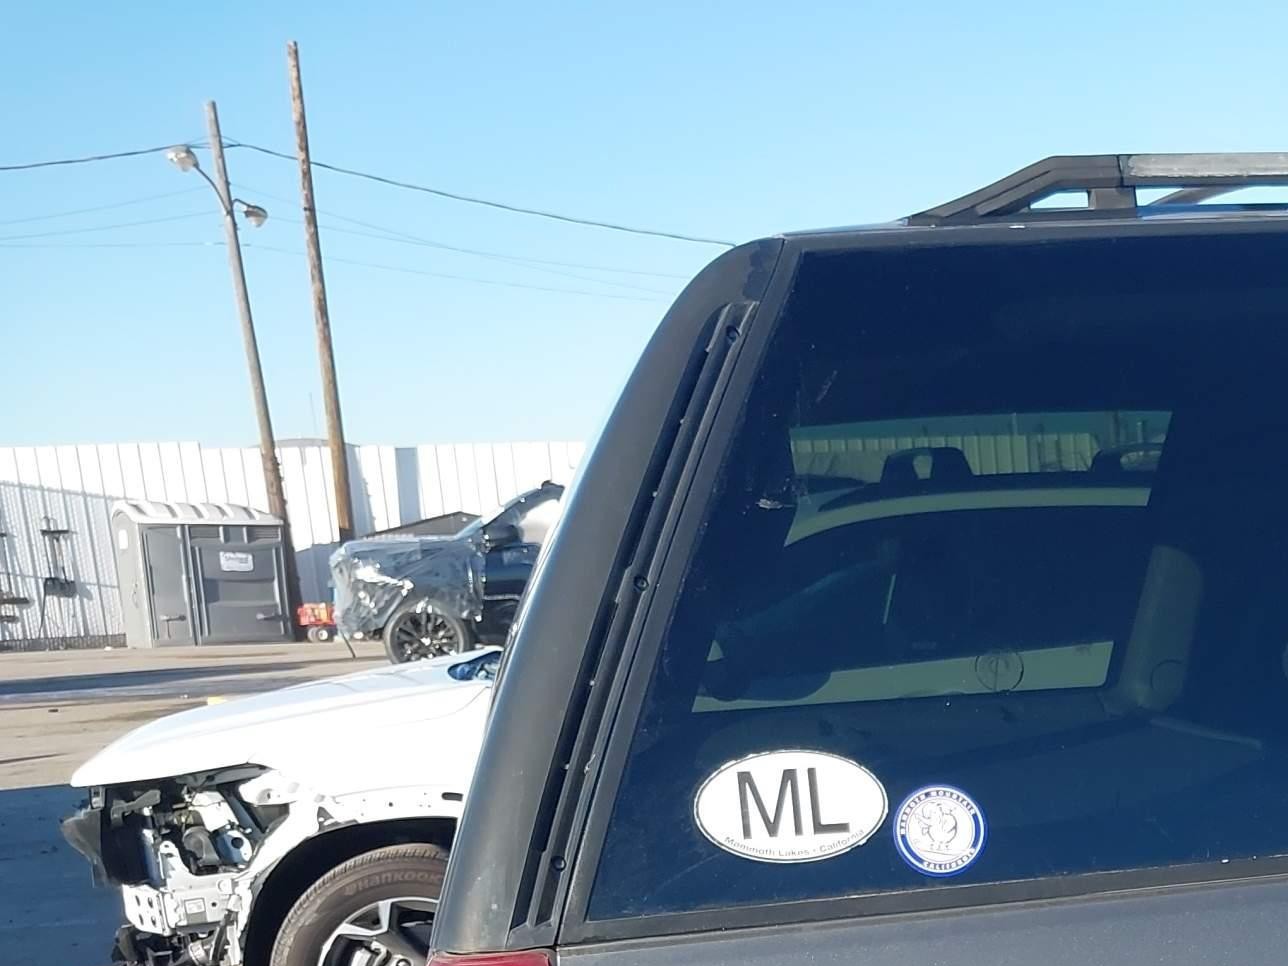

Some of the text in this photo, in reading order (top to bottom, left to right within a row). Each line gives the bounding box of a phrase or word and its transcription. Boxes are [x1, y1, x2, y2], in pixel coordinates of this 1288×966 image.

[737, 767, 850, 840] ML
[724, 829, 865, 858] Mammoth Lakes California
